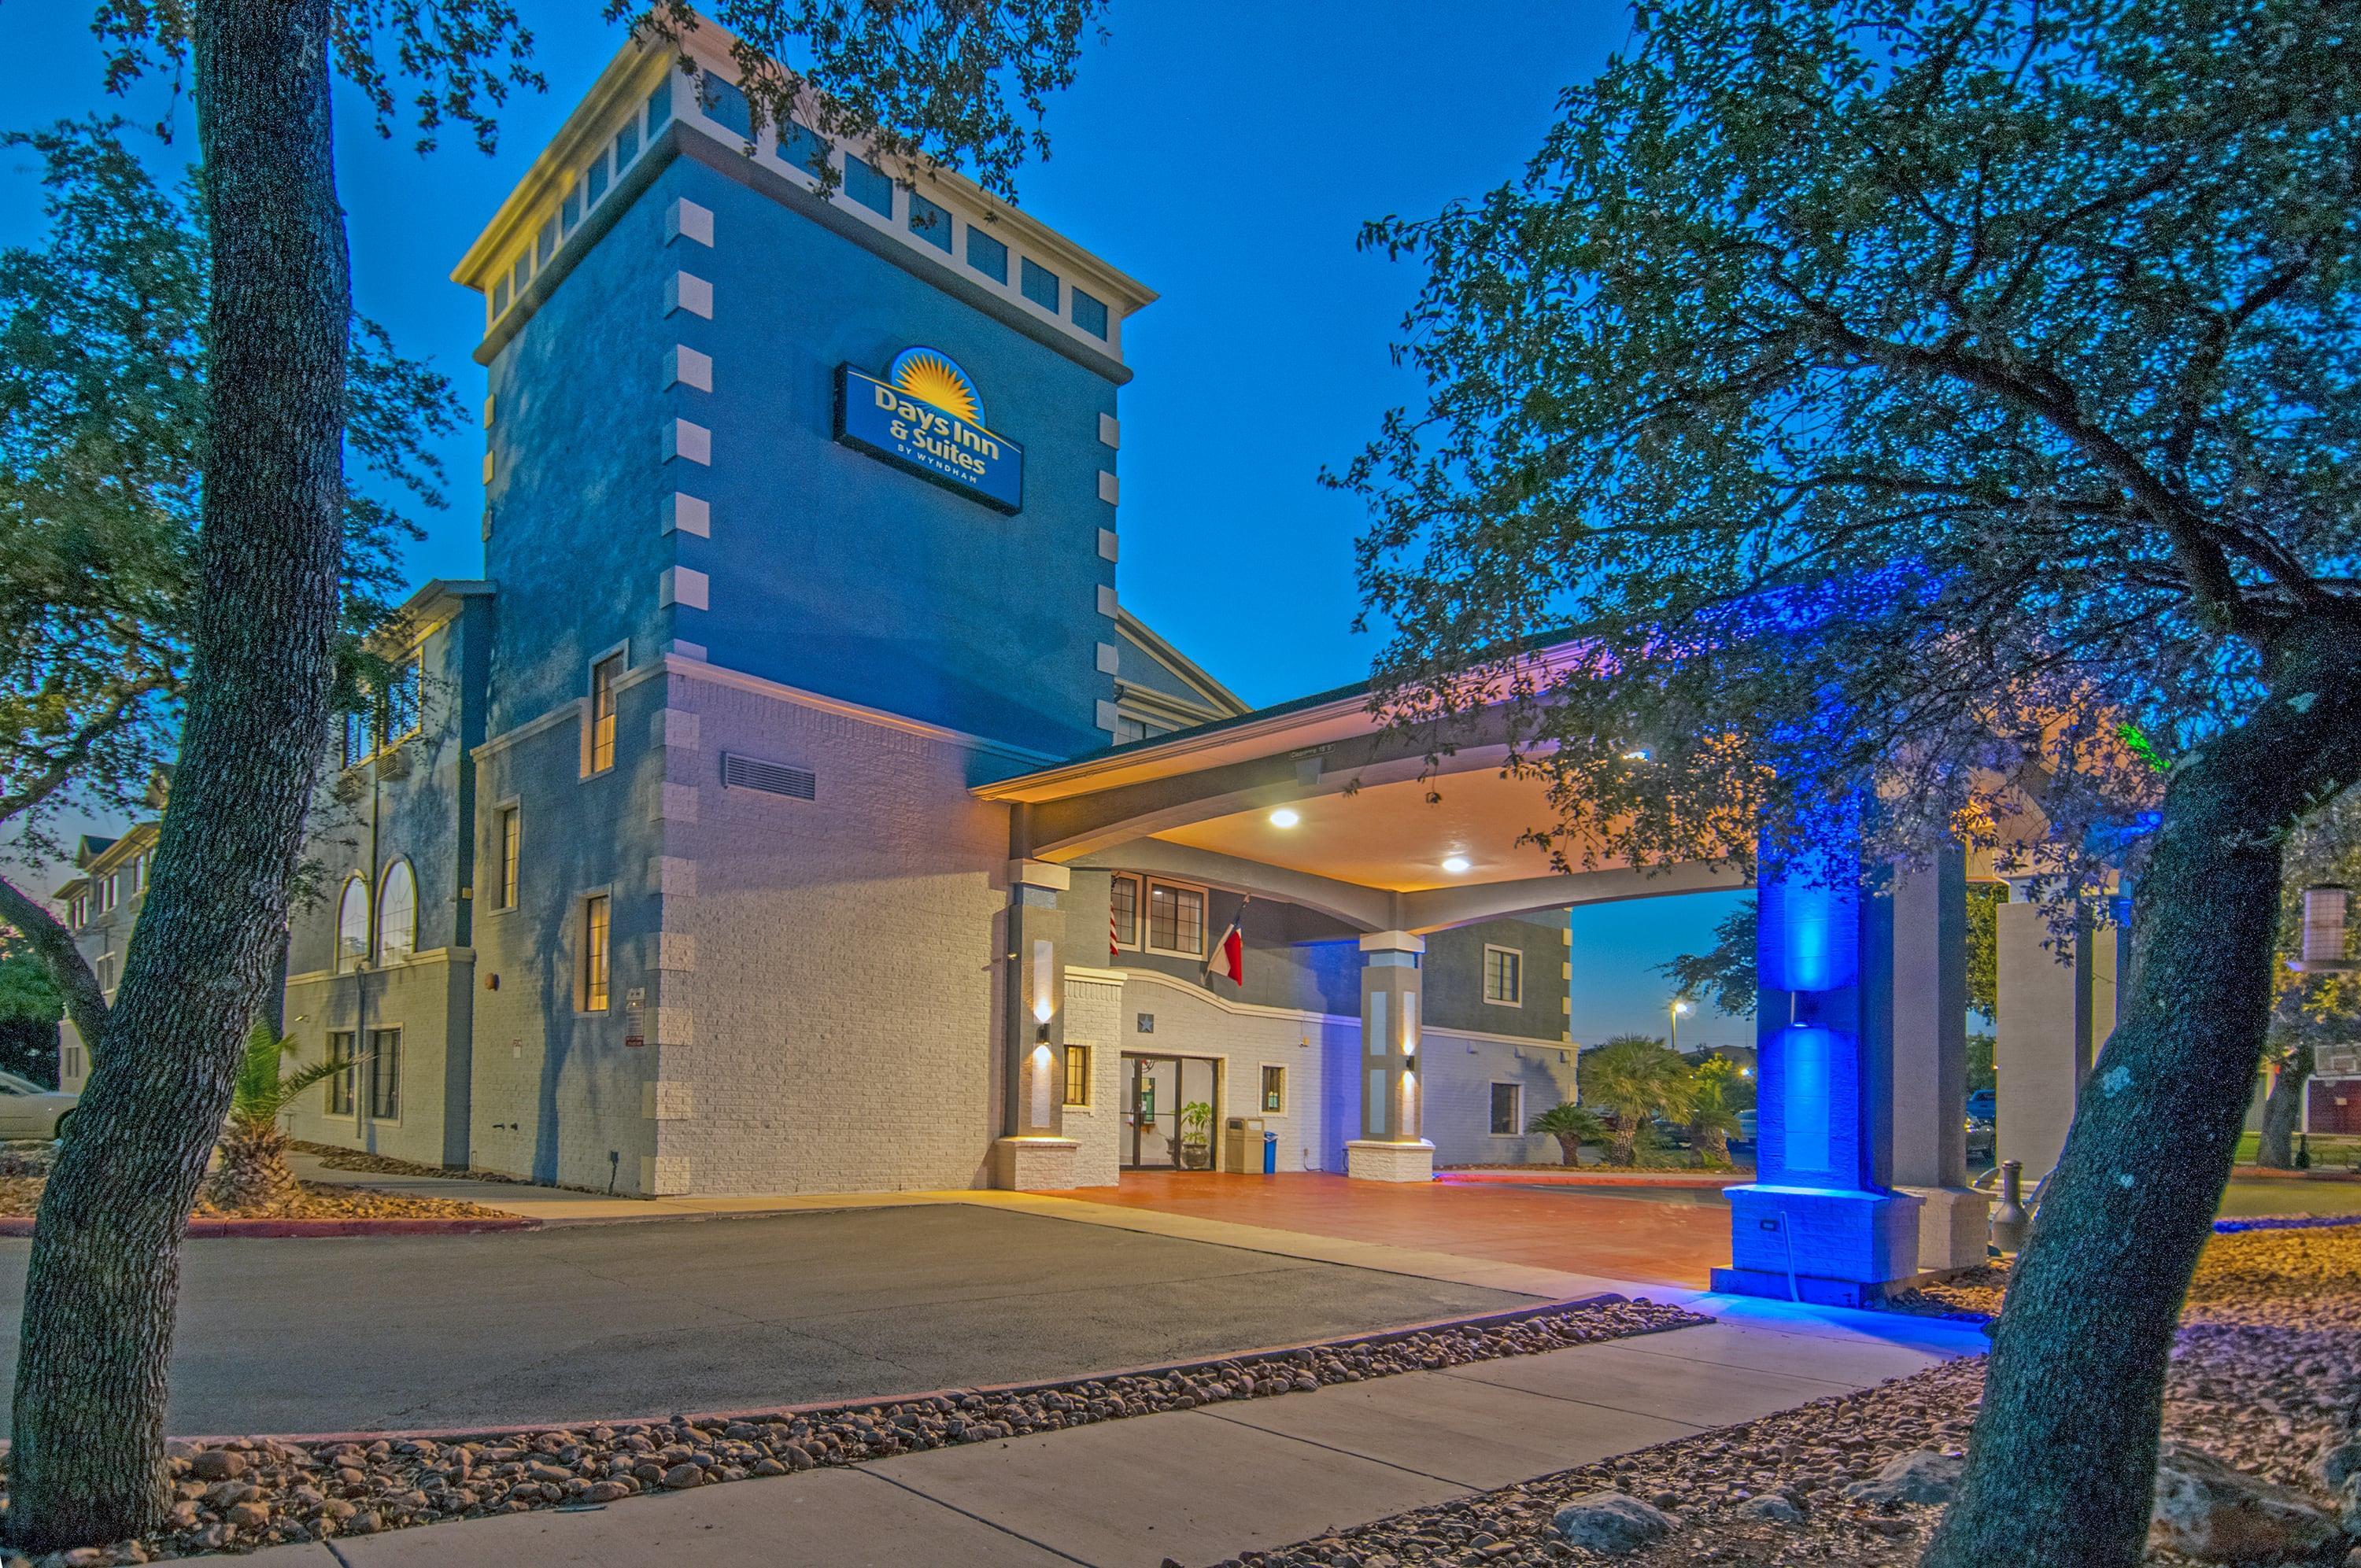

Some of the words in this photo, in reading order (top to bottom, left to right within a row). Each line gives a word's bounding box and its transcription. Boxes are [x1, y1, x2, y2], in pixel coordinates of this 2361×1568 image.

[875, 386, 949, 436] Days
[954, 421, 999, 460] Inn
[890, 420, 908, 441] &
[912, 428, 985, 474] Suites
[897, 445, 912, 455] BY
[917, 454, 977, 483] WYNDHAM
